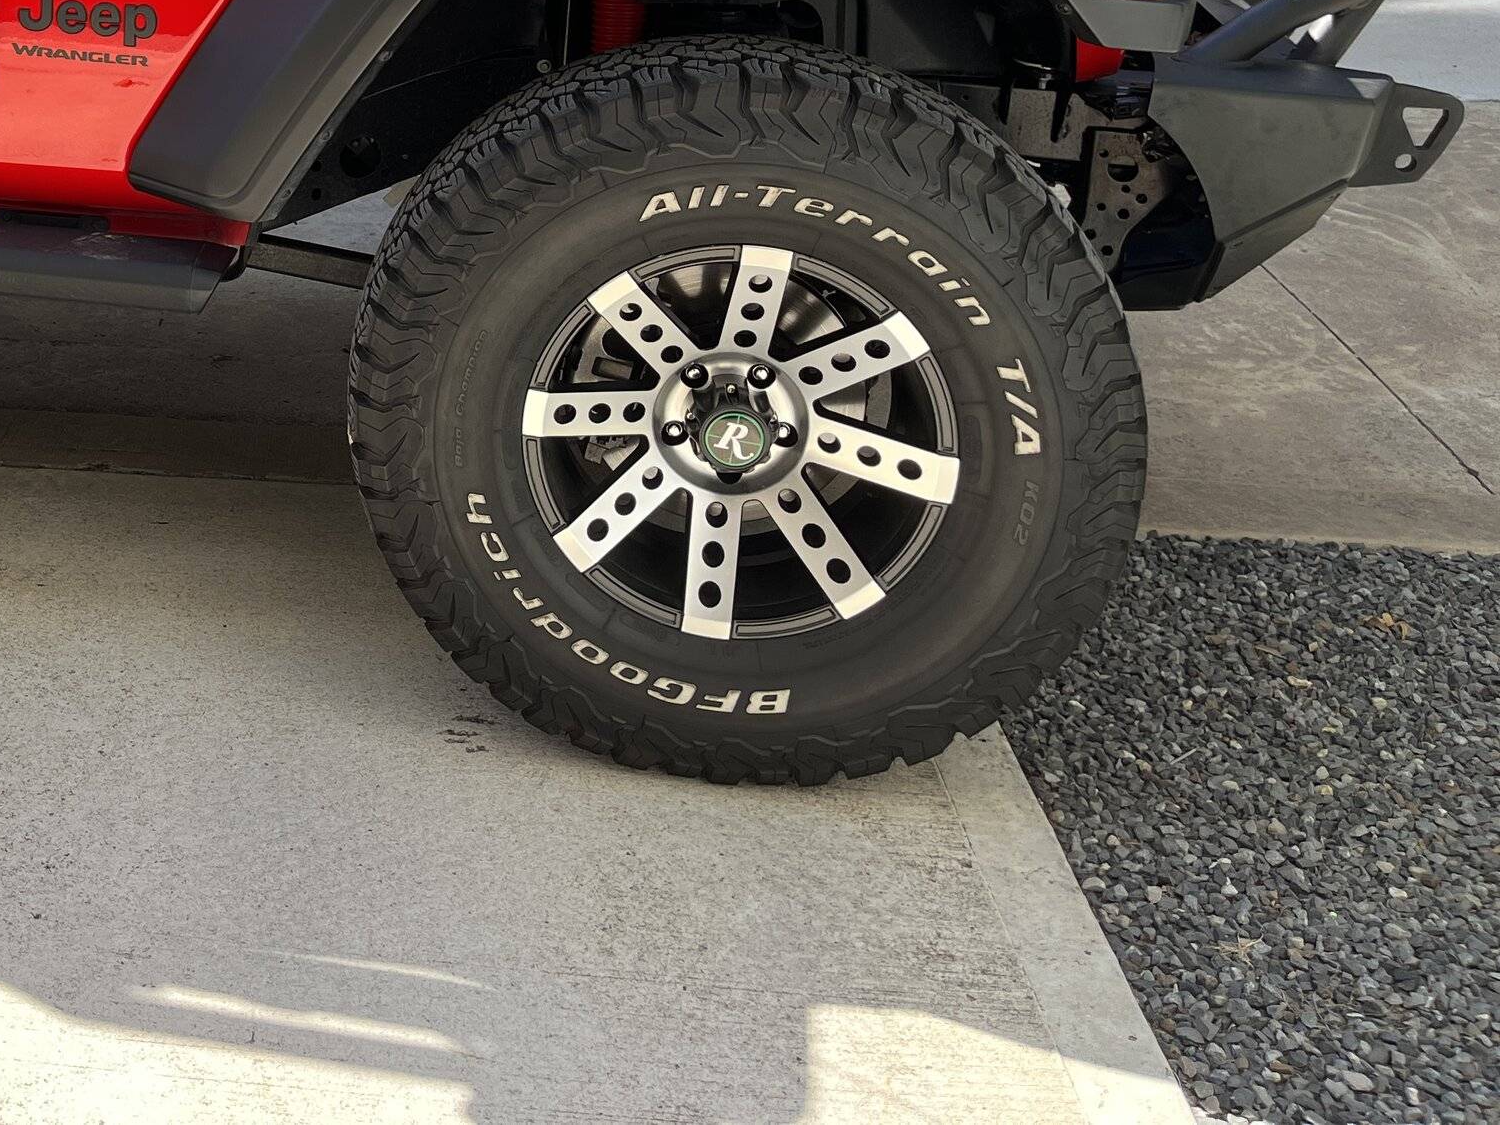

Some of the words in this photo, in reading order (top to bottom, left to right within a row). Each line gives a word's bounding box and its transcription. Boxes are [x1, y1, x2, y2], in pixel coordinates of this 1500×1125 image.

[11, 42, 149, 67] WRANGLER
[638, 183, 993, 327] All-Terrain
[995, 358, 1041, 456] T/A
[713, 421, 755, 461] R
[465, 492, 793, 716] BFGoodrich
